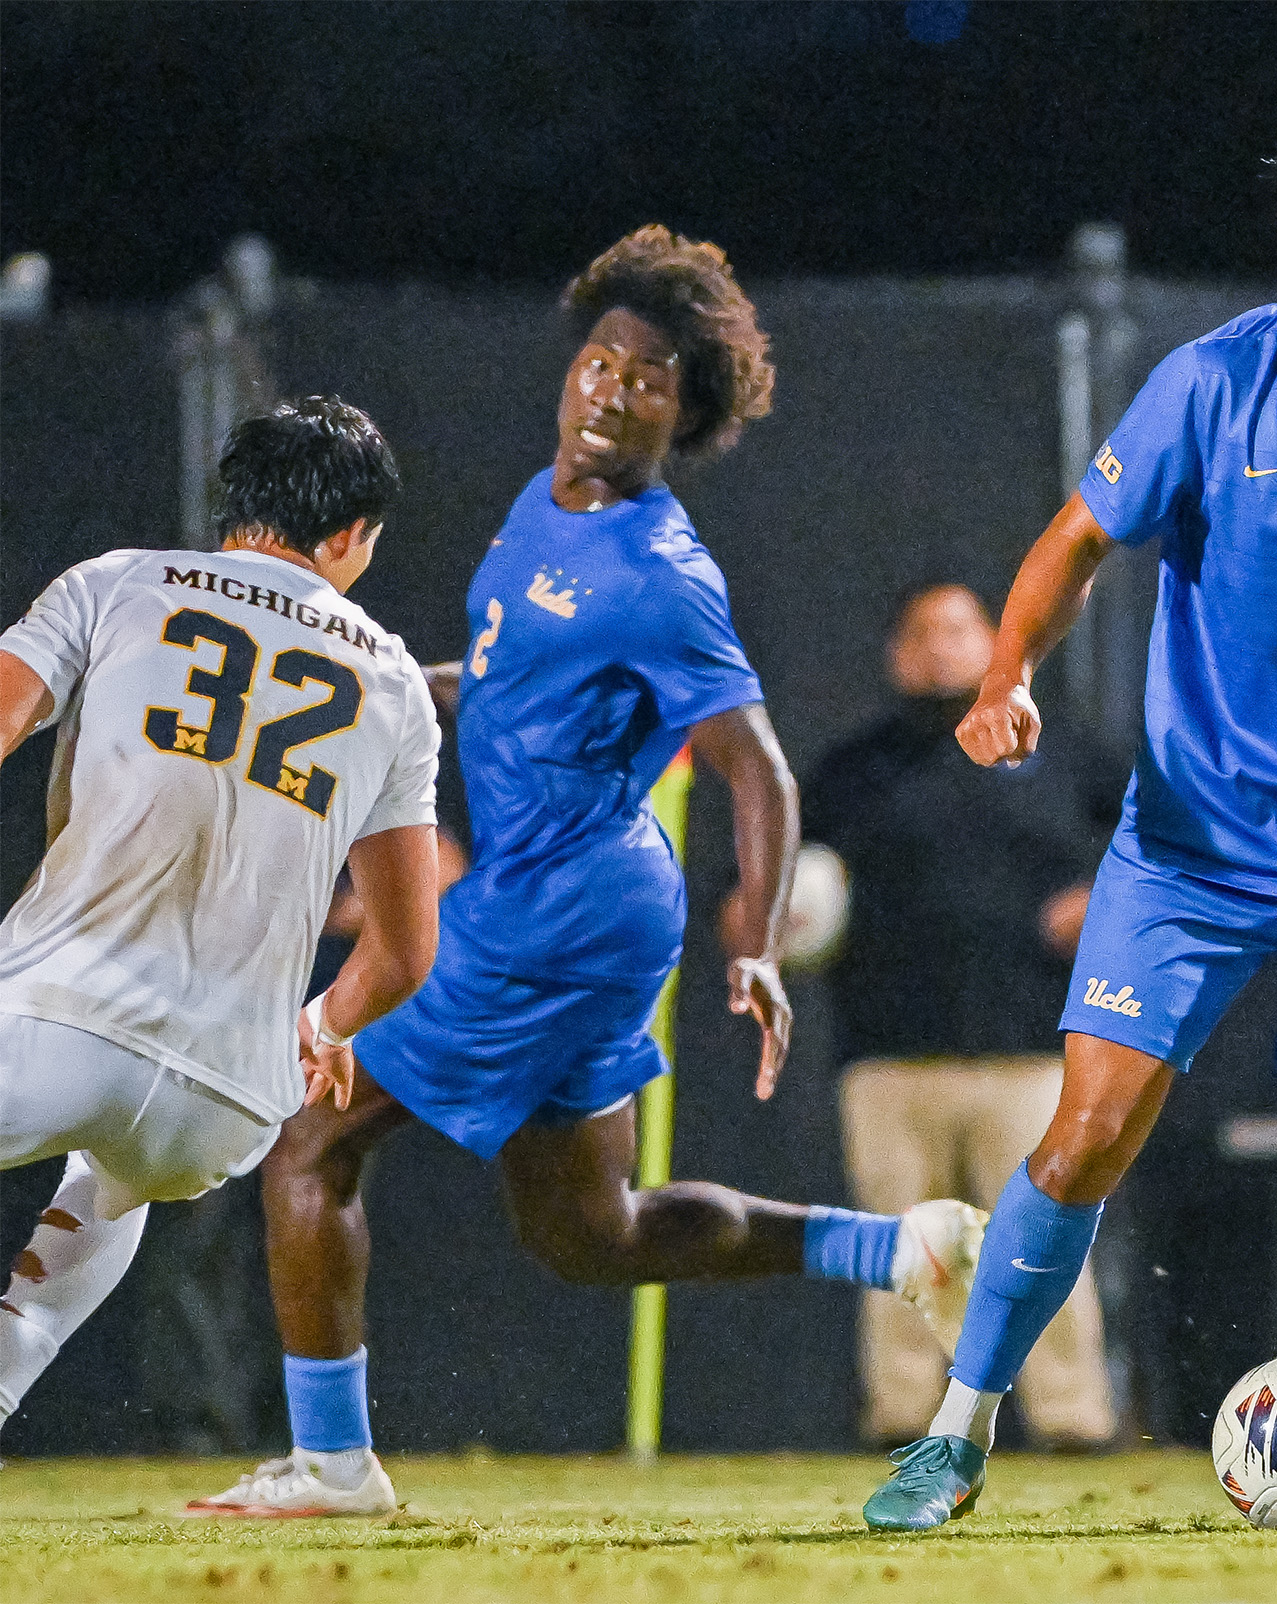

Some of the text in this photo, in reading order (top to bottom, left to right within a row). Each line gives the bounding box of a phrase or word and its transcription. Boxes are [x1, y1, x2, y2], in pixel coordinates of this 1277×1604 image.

[162, 565, 378, 658] MICHIGAN
[469, 597, 503, 679] 2
[142, 606, 366, 821] 32
[173, 728, 208, 755] M
[276, 767, 309, 800] M
[1083, 977, 1142, 1018] Ucla
